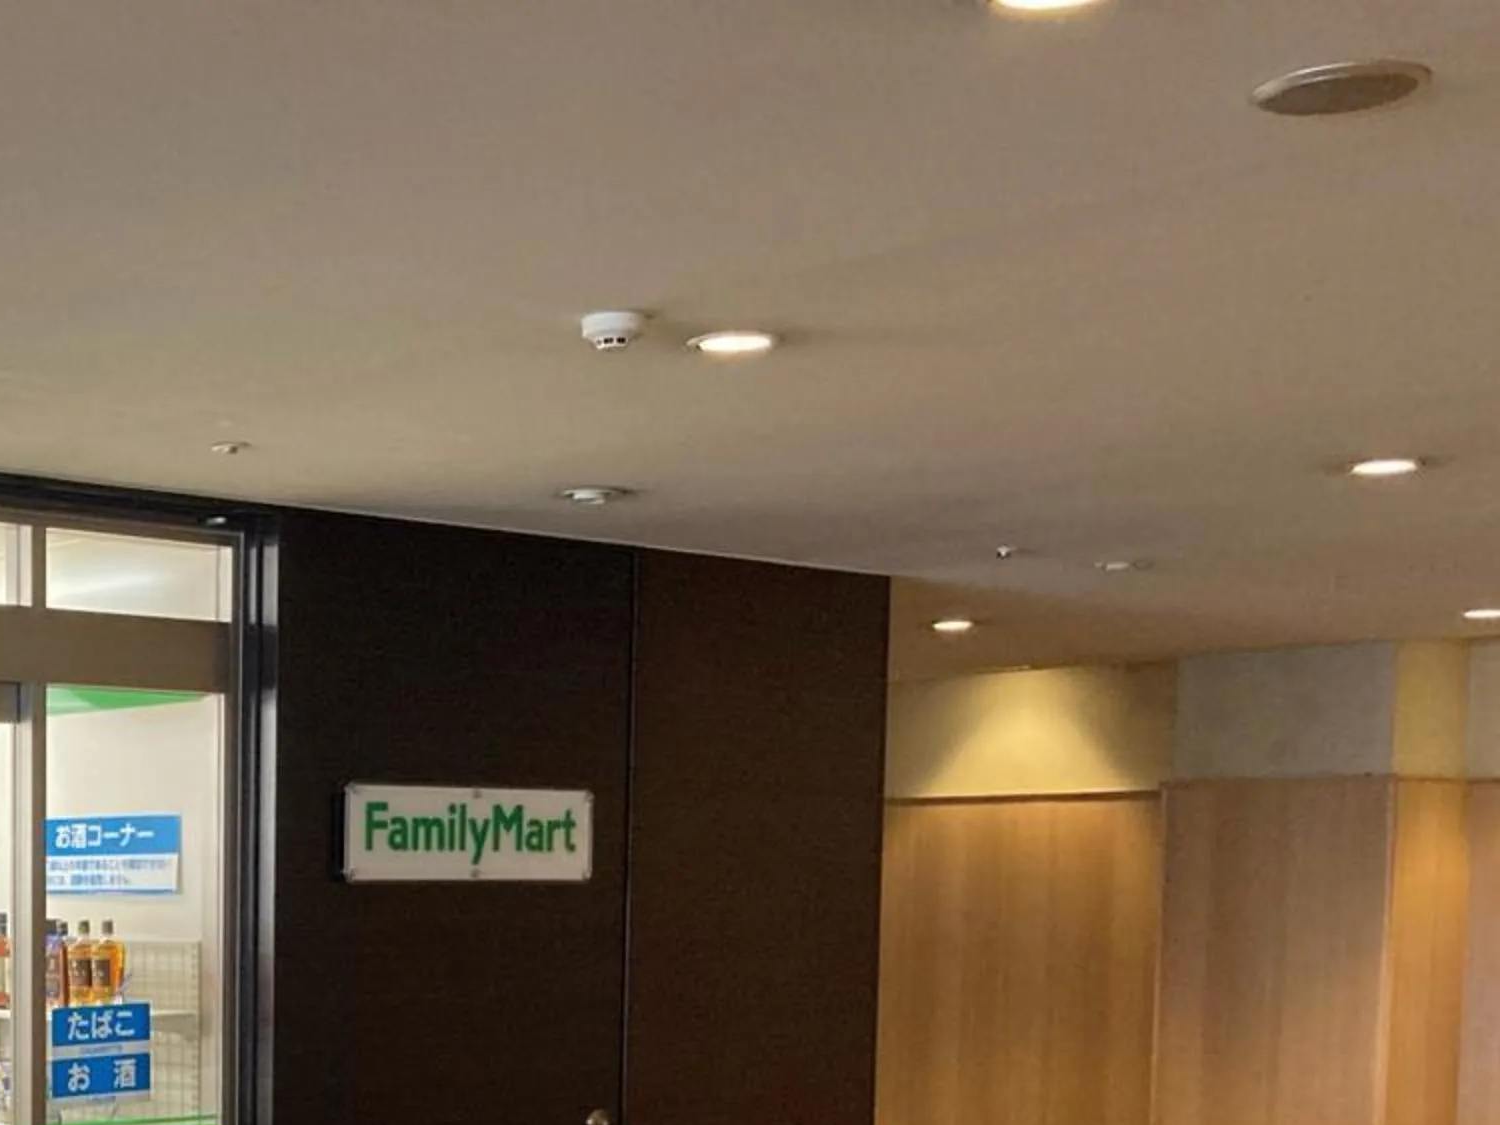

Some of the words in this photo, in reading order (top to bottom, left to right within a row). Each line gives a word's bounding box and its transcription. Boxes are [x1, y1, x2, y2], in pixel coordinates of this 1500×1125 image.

[55, 822, 154, 849] お酒コーナー
[365, 802, 576, 865] FamilyMart
[67, 1010, 135, 1040] たばこ
